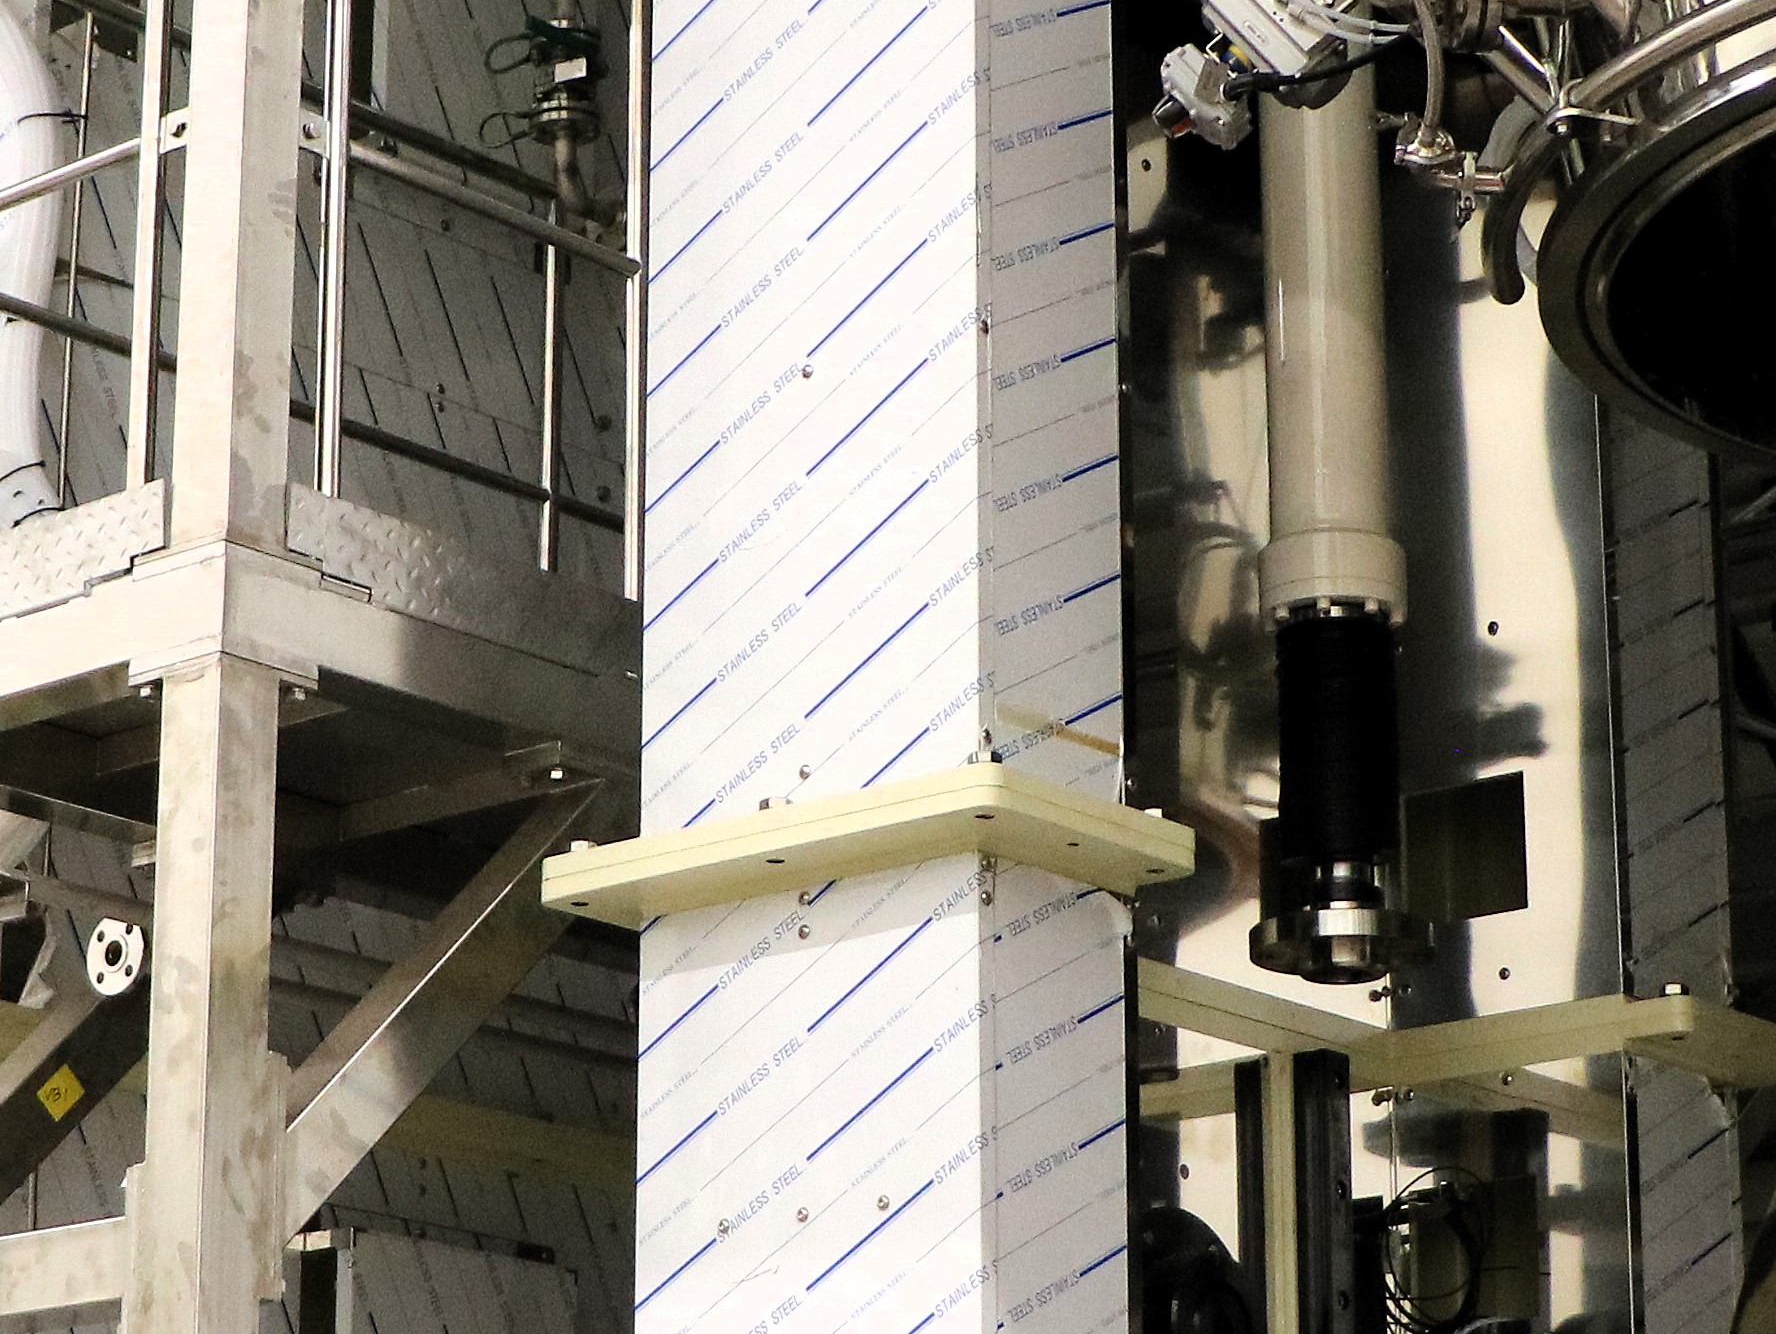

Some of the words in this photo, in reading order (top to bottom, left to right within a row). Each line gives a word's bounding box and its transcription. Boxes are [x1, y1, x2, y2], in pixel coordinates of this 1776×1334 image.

[724, 46, 774, 102] STAINLESS
[776, 14, 806, 49] STEEL
[723, 159, 773, 214] STAINLESS
[775, 127, 805, 162] STEEL
[721, 390, 771, 444] STAINLESS
[774, 358, 804, 393] STEEL
[718, 628, 769, 682] STAINLESS
[772, 597, 802, 631] STEEL
[716, 750, 768, 803] STAINLESS
[770, 719, 801, 753] STEEL
[719, 937, 771, 989] STAINLESS
[774, 907, 805, 940] STEEL
[718, 1063, 771, 1115] STAINLESS
[773, 1033, 805, 1067] STEEL
